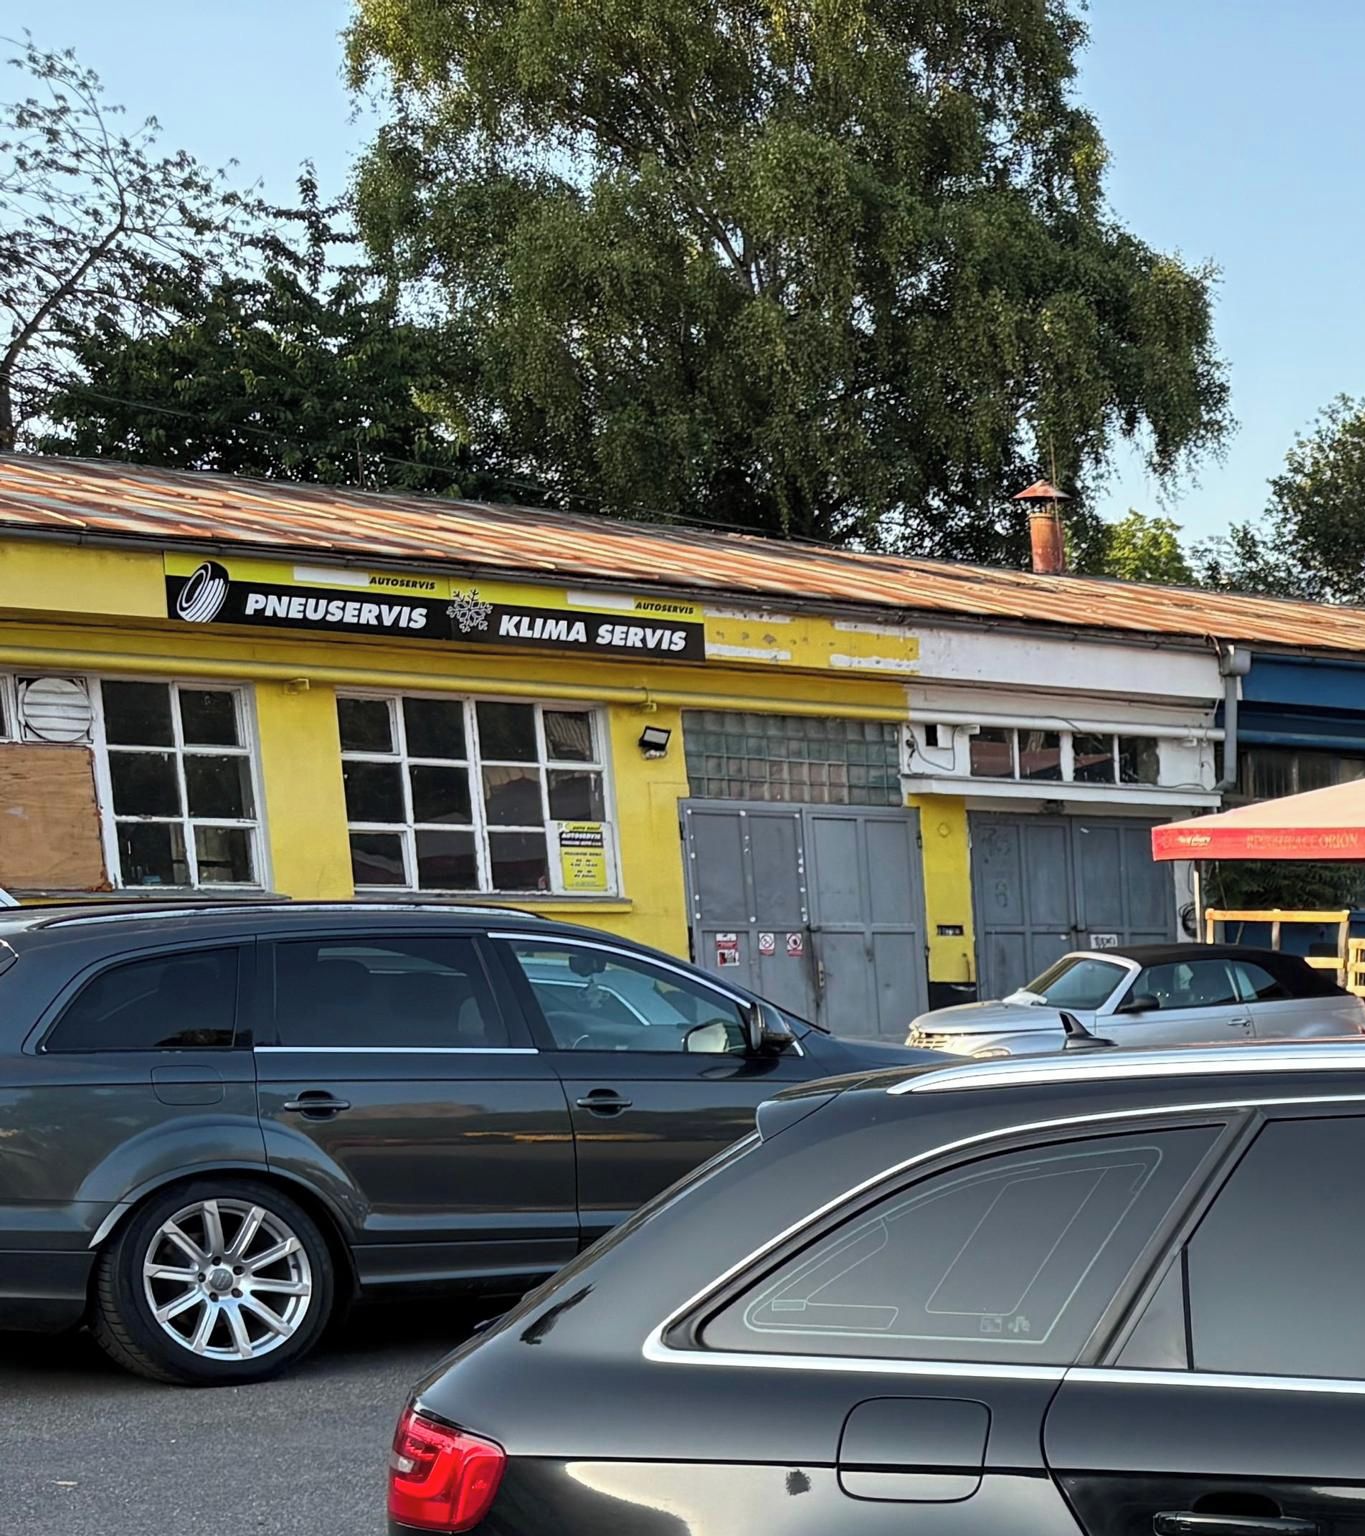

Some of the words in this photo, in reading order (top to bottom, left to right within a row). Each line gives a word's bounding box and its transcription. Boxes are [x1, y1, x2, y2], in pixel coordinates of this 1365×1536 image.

[369, 576, 436, 590] AUTOSERVIS
[244, 593, 428, 629] PNEUSERVIS
[635, 601, 694, 615] AUTOSERVIS
[499, 615, 588, 643] KLIMA
[596, 623, 687, 651] SERVIS
